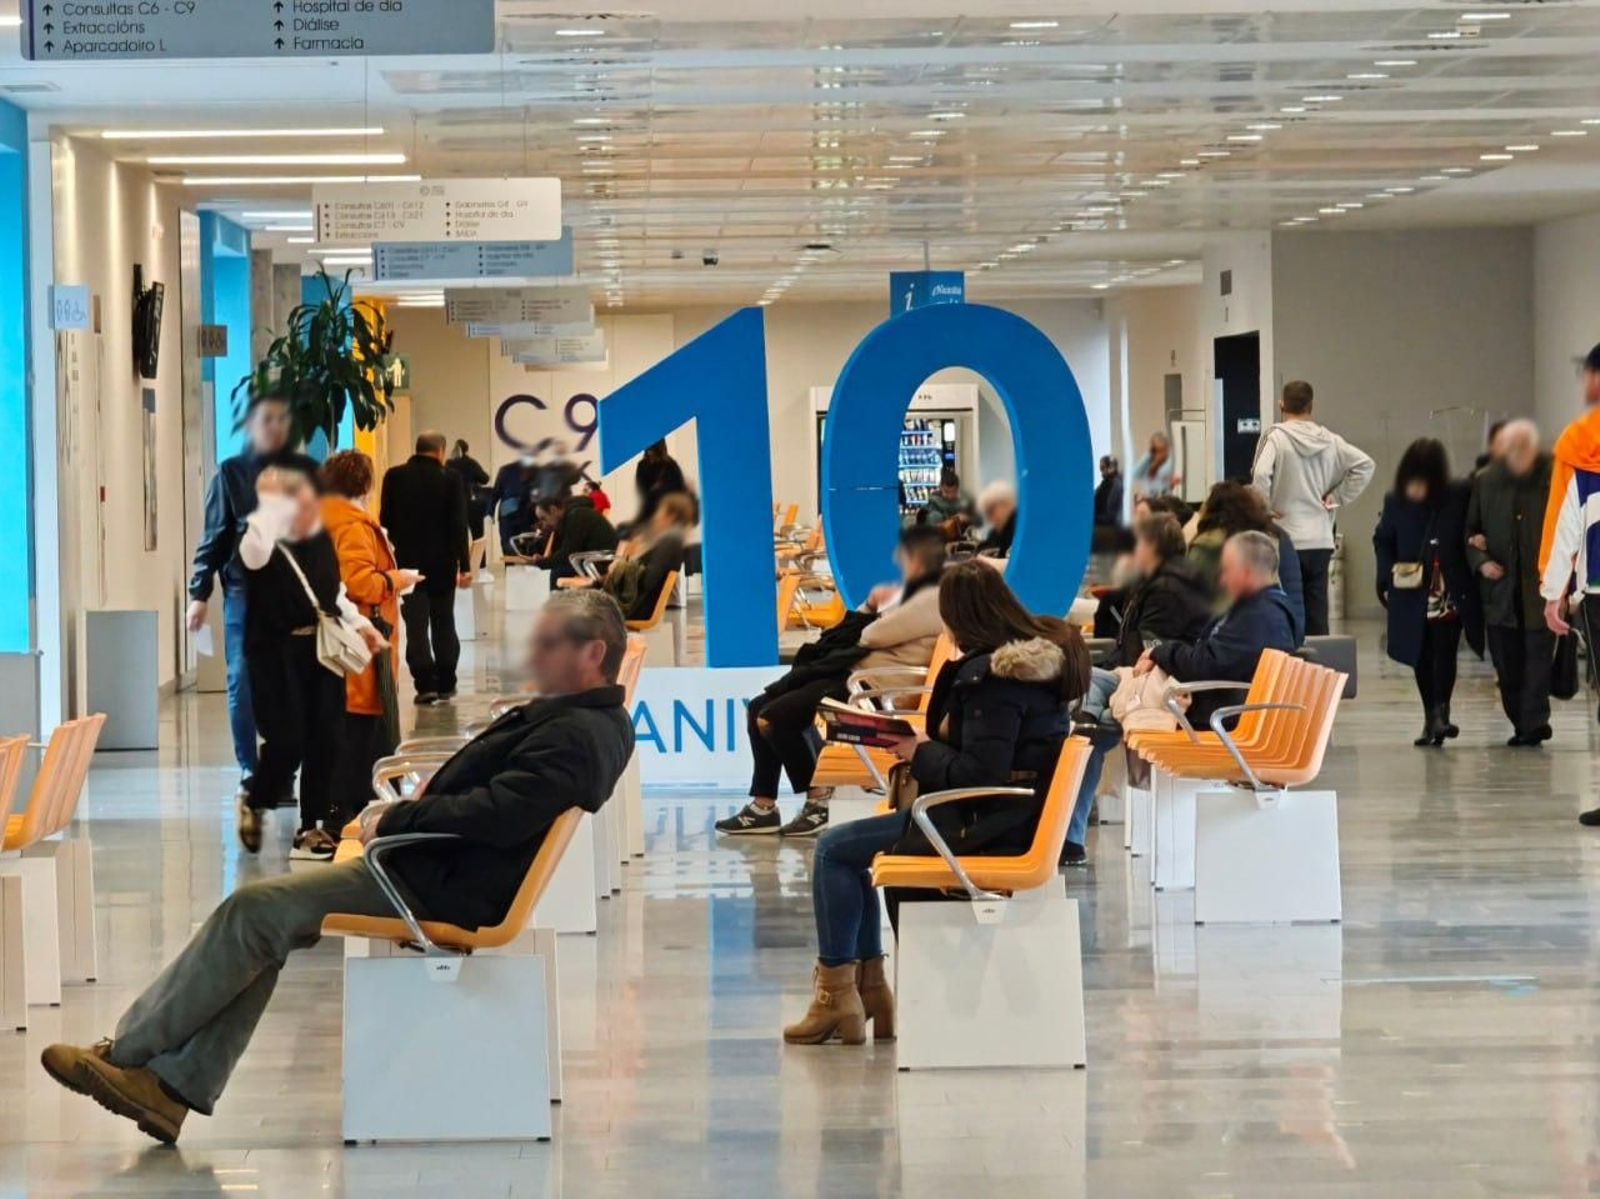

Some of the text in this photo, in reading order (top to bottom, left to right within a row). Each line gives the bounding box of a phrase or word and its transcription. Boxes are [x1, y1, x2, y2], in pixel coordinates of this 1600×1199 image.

[62, 1, 134, 16] Consultas
[138, 2, 160, 16] C6
[174, 1, 196, 15] C9
[293, 0, 350, 14] Hospital
[354, 0, 374, 12] de
[62, 20, 146, 35] Extraccións
[293, 18, 340, 31] Diálise
[62, 38, 168, 54] Aparcadoiro L
[293, 36, 364, 50] Farmacia
[495, 393, 599, 453] C9
[631, 697, 751, 754] ANI
